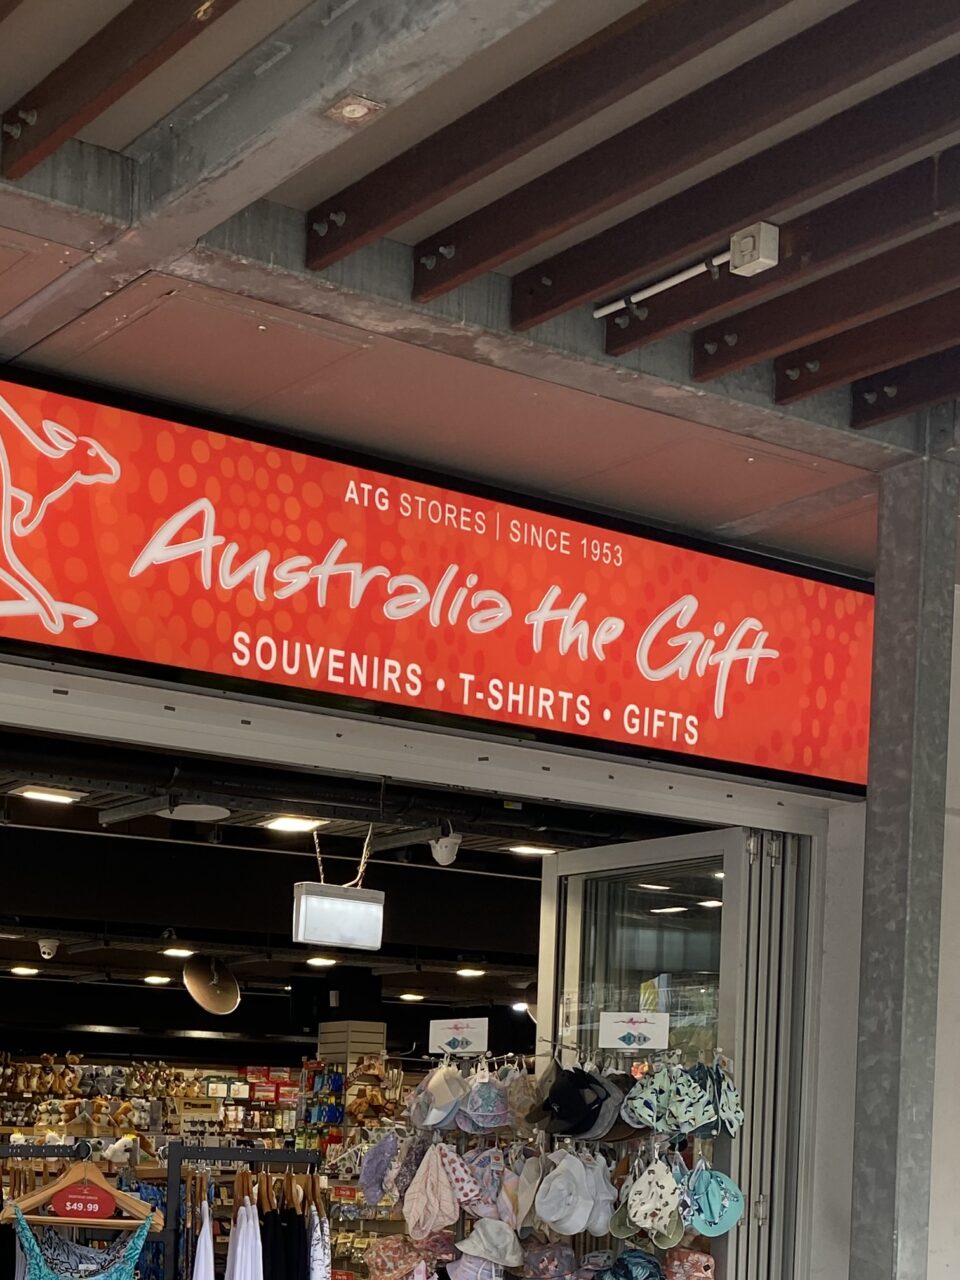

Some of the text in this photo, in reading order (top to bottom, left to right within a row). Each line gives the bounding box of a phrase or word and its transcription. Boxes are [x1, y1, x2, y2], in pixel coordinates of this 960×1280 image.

[344, 480, 624, 567] ATG STORES SINCE 1953
[129, 497, 780, 719] Australia the Gift
[232, 630, 699, 745] SOUVENIRS T-SHIRTS GIFTS
[65, 1201, 99, 1212] $49.99
